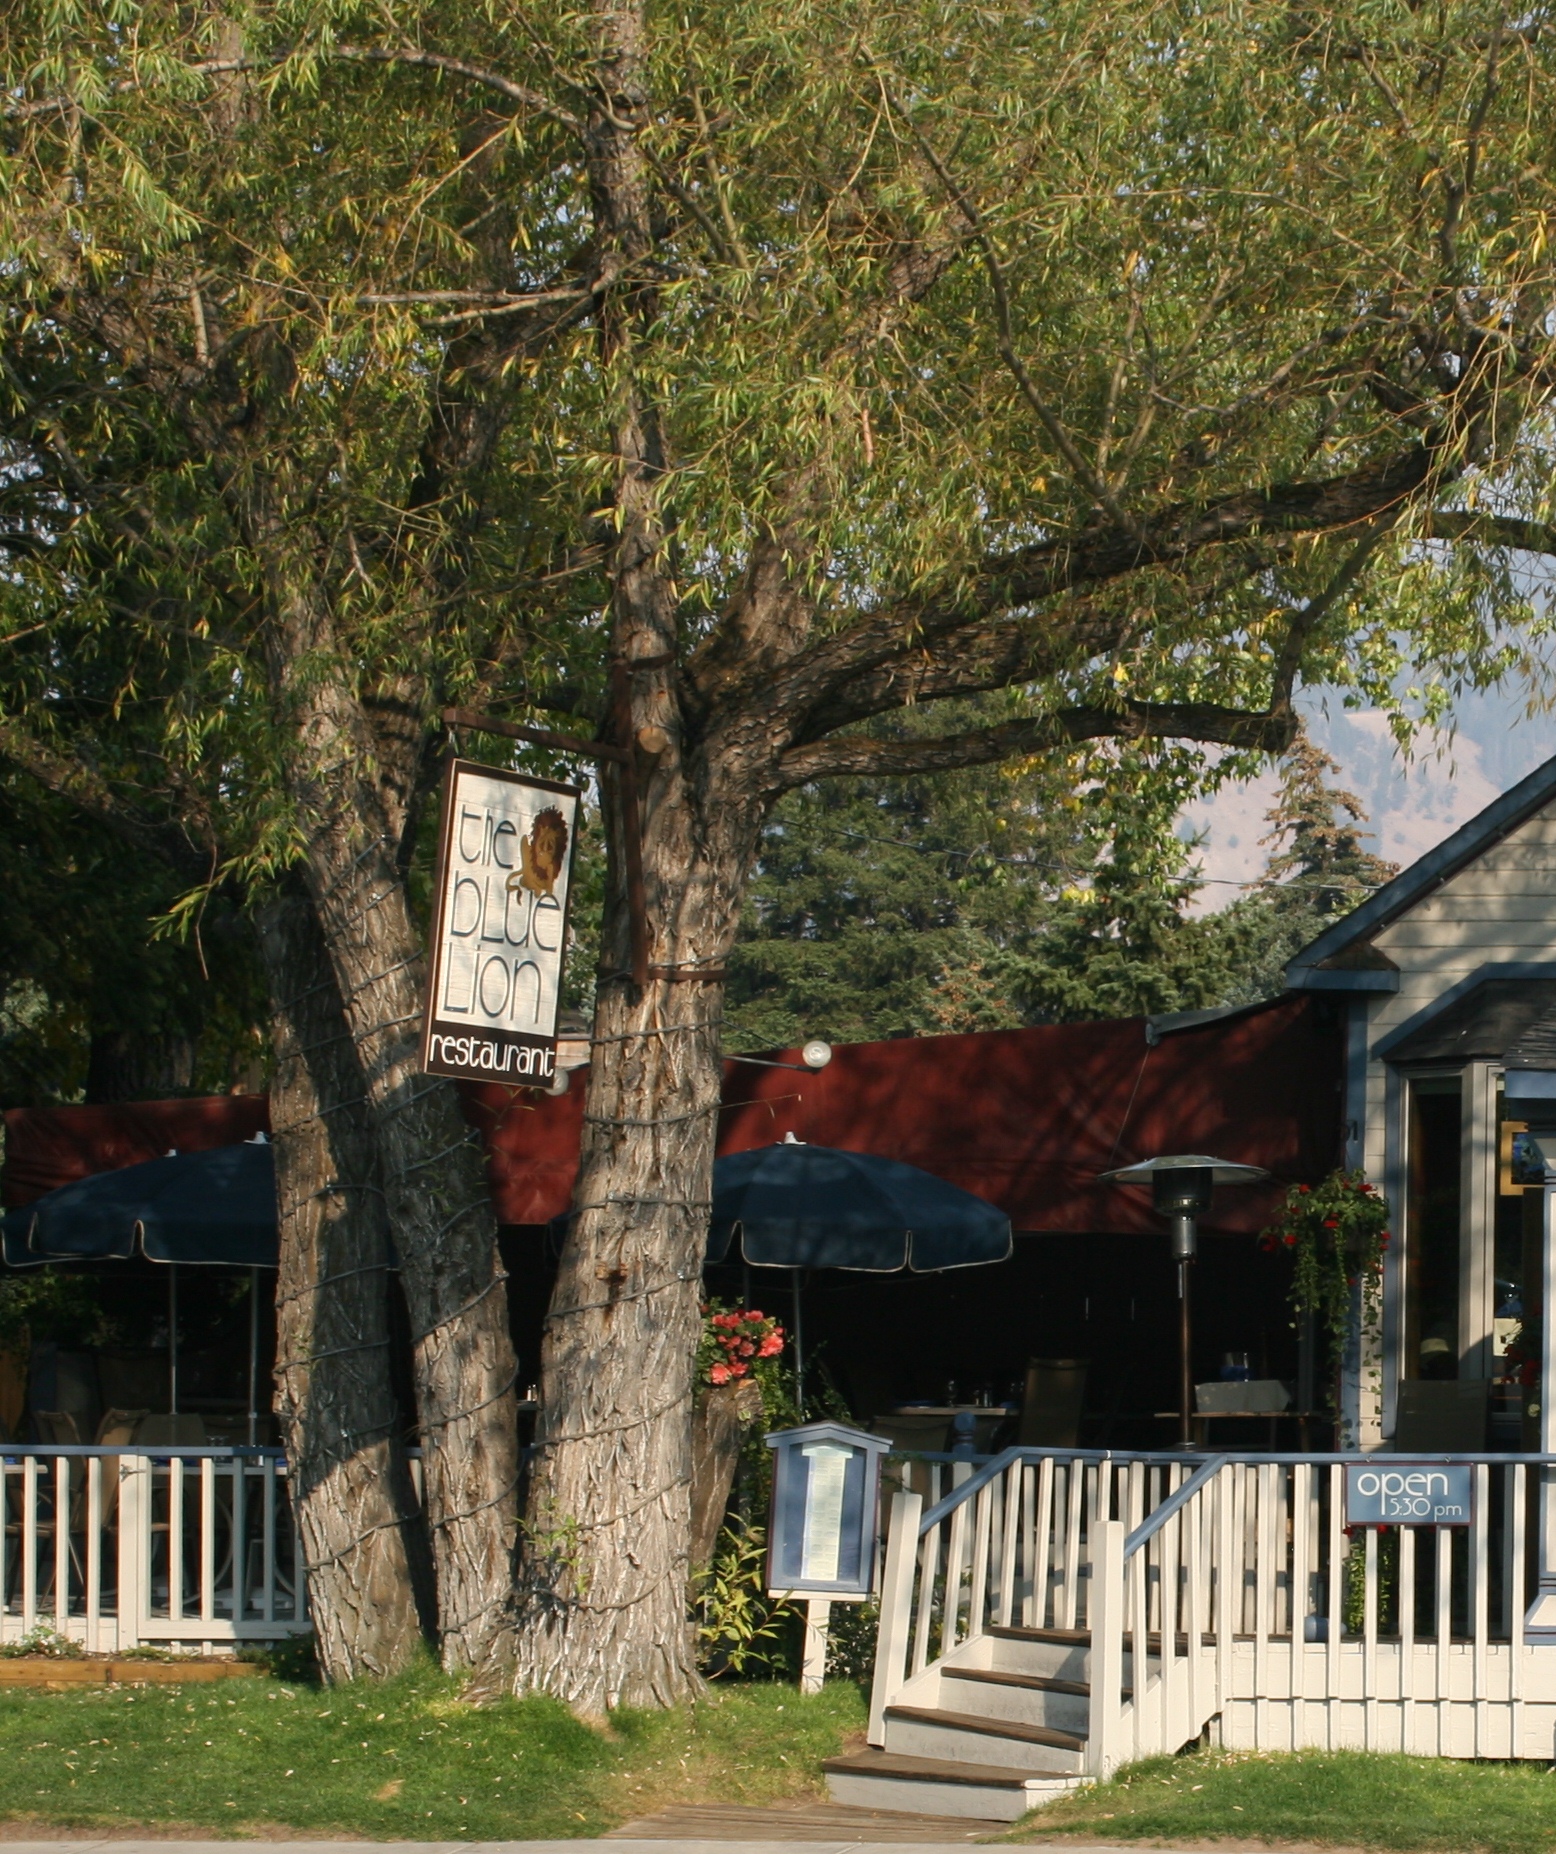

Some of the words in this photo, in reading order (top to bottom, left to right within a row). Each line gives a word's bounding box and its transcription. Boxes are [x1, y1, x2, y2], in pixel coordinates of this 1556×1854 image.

[429, 1032, 555, 1078] restaurant
[1357, 1473, 1448, 1516] open
[1390, 1497, 1431, 1516] 5:30
[1434, 1505, 1462, 1522] pm
